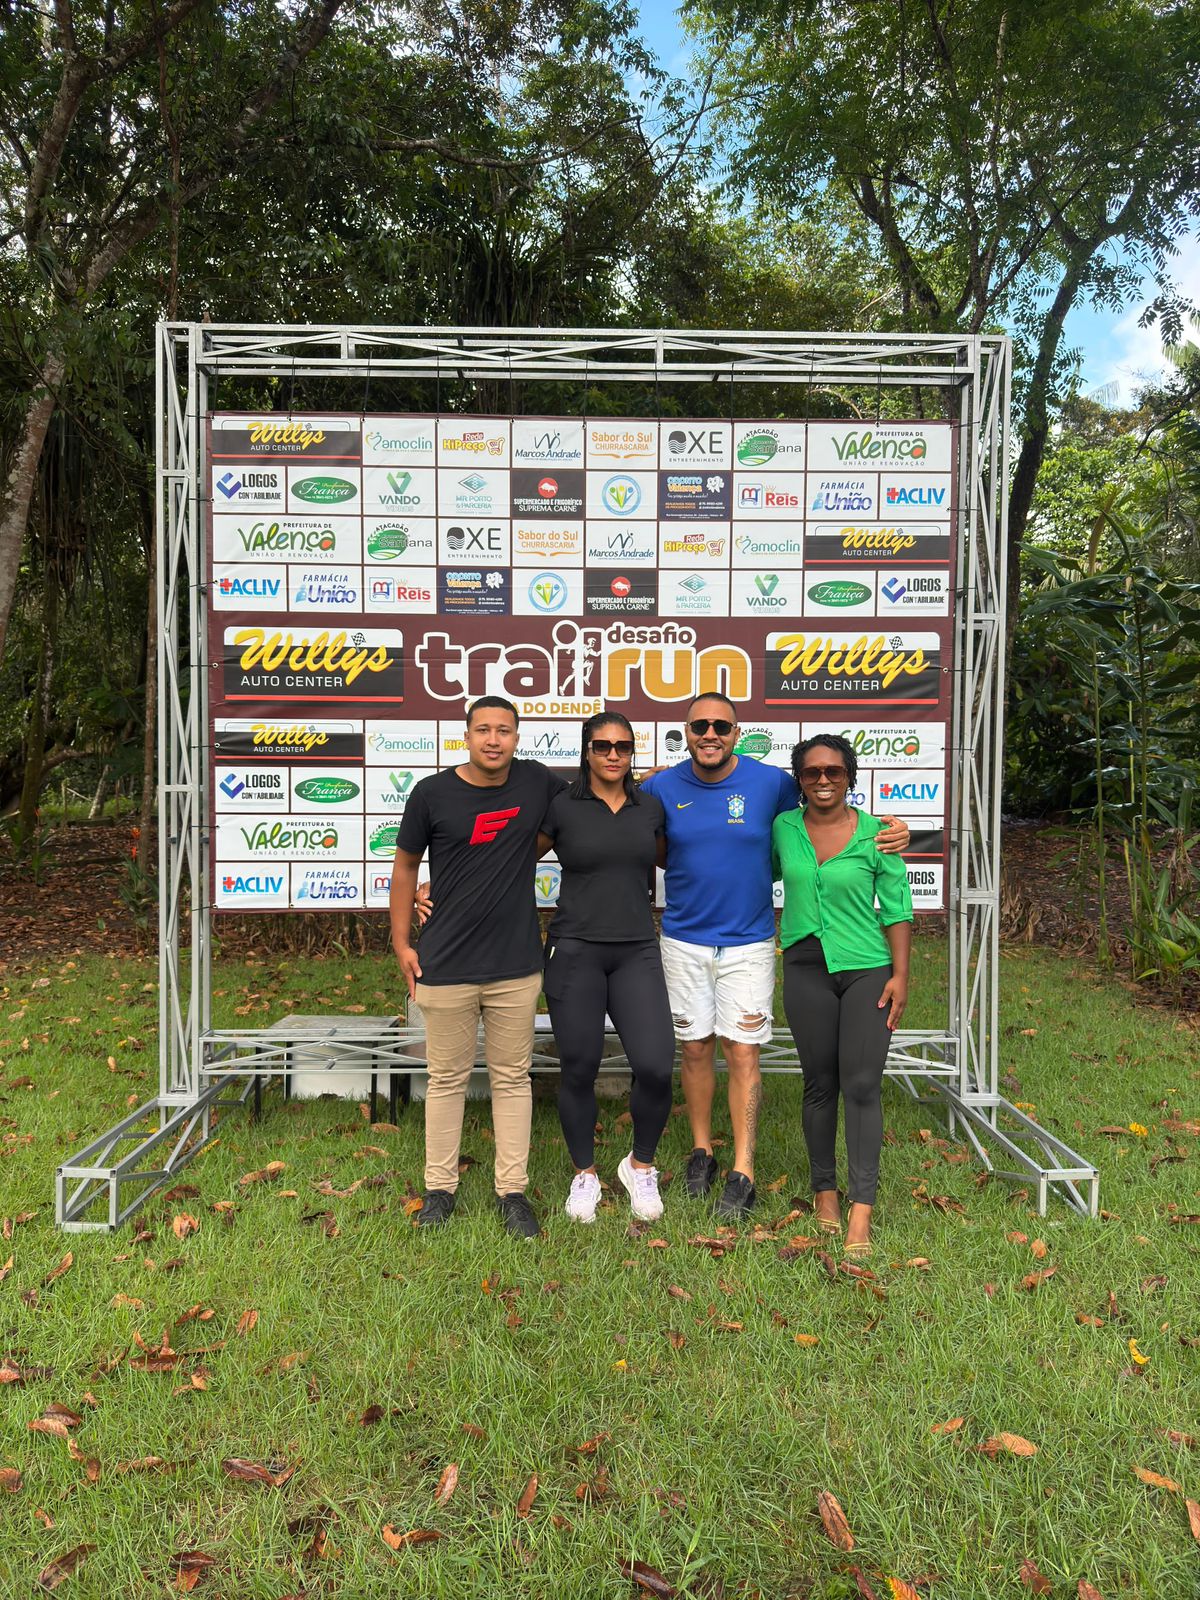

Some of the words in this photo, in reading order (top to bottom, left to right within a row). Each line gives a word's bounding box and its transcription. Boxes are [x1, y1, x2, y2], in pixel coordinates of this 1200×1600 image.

[247, 421, 326, 450] Willys
[466, 433, 484, 441] Rede
[592, 432, 620, 442] Sabor
[622, 432, 635, 442] do
[637, 432, 653, 442] Sul
[746, 428, 779, 438] ATACADÃO
[382, 437, 432, 450] amoclin
[595, 443, 649, 451] CHURRASCARIA
[515, 449, 545, 458] Marcos
[546, 449, 581, 459] Andrade
[242, 473, 278, 488] LOGOS
[820, 481, 865, 490] FARMÁCIA
[299, 481, 351, 496] França
[379, 495, 421, 505] VANDO
[766, 492, 799, 506] Reis
[824, 492, 873, 511] União
[896, 487, 945, 504] ACLIV
[375, 522, 409, 533] ATACADÃO
[518, 530, 545, 540] Sabor
[548, 531, 560, 540] do
[563, 531, 578, 541] Sul
[686, 534, 704, 542] Rede
[841, 527, 917, 555] Willys
[751, 540, 800, 552] amoclin
[588, 549, 618, 558] Marcos
[619, 549, 654, 558] Andrade
[303, 574, 349, 582] FARMÁCIA
[230, 579, 281, 595] ACLIV
[907, 578, 941, 592] LOGOS
[308, 585, 357, 603] União
[397, 587, 431, 600] Reis
[815, 585, 865, 599] França
[746, 597, 787, 607] VANDO
[608, 624, 693, 644] desafio
[234, 628, 394, 686] Willys
[417, 621, 603, 699] trail
[607, 648, 749, 699] run
[775, 634, 930, 689] Willys
[240, 675, 280, 687] AUTO
[285, 676, 343, 687] CENTER
[781, 679, 819, 691] AUTO
[823, 680, 879, 691] CENTER
[523, 702, 546, 714] DO
[550, 699, 601, 714] DENDÊ
[251, 723, 329, 751] Willys
[635, 731, 650, 740] Sul
[741, 727, 774, 737] ATACADÃO
[384, 737, 434, 750] amoclin
[444, 739, 469, 751] HiPr
[515, 748, 544, 757] Marcos
[545, 748, 580, 757] Andrade
[245, 774, 281, 788] LOGOS
[302, 781, 353, 797] França
[890, 784, 939, 800] ACLIV
[378, 820, 401, 828] ATACAD
[305, 870, 351, 879] FARMÁCIA
[907, 871, 935, 884] OGOS
[233, 876, 284, 893] ACLIV
[310, 881, 358, 900] União
[911, 888, 939, 896] ABILIDADE
